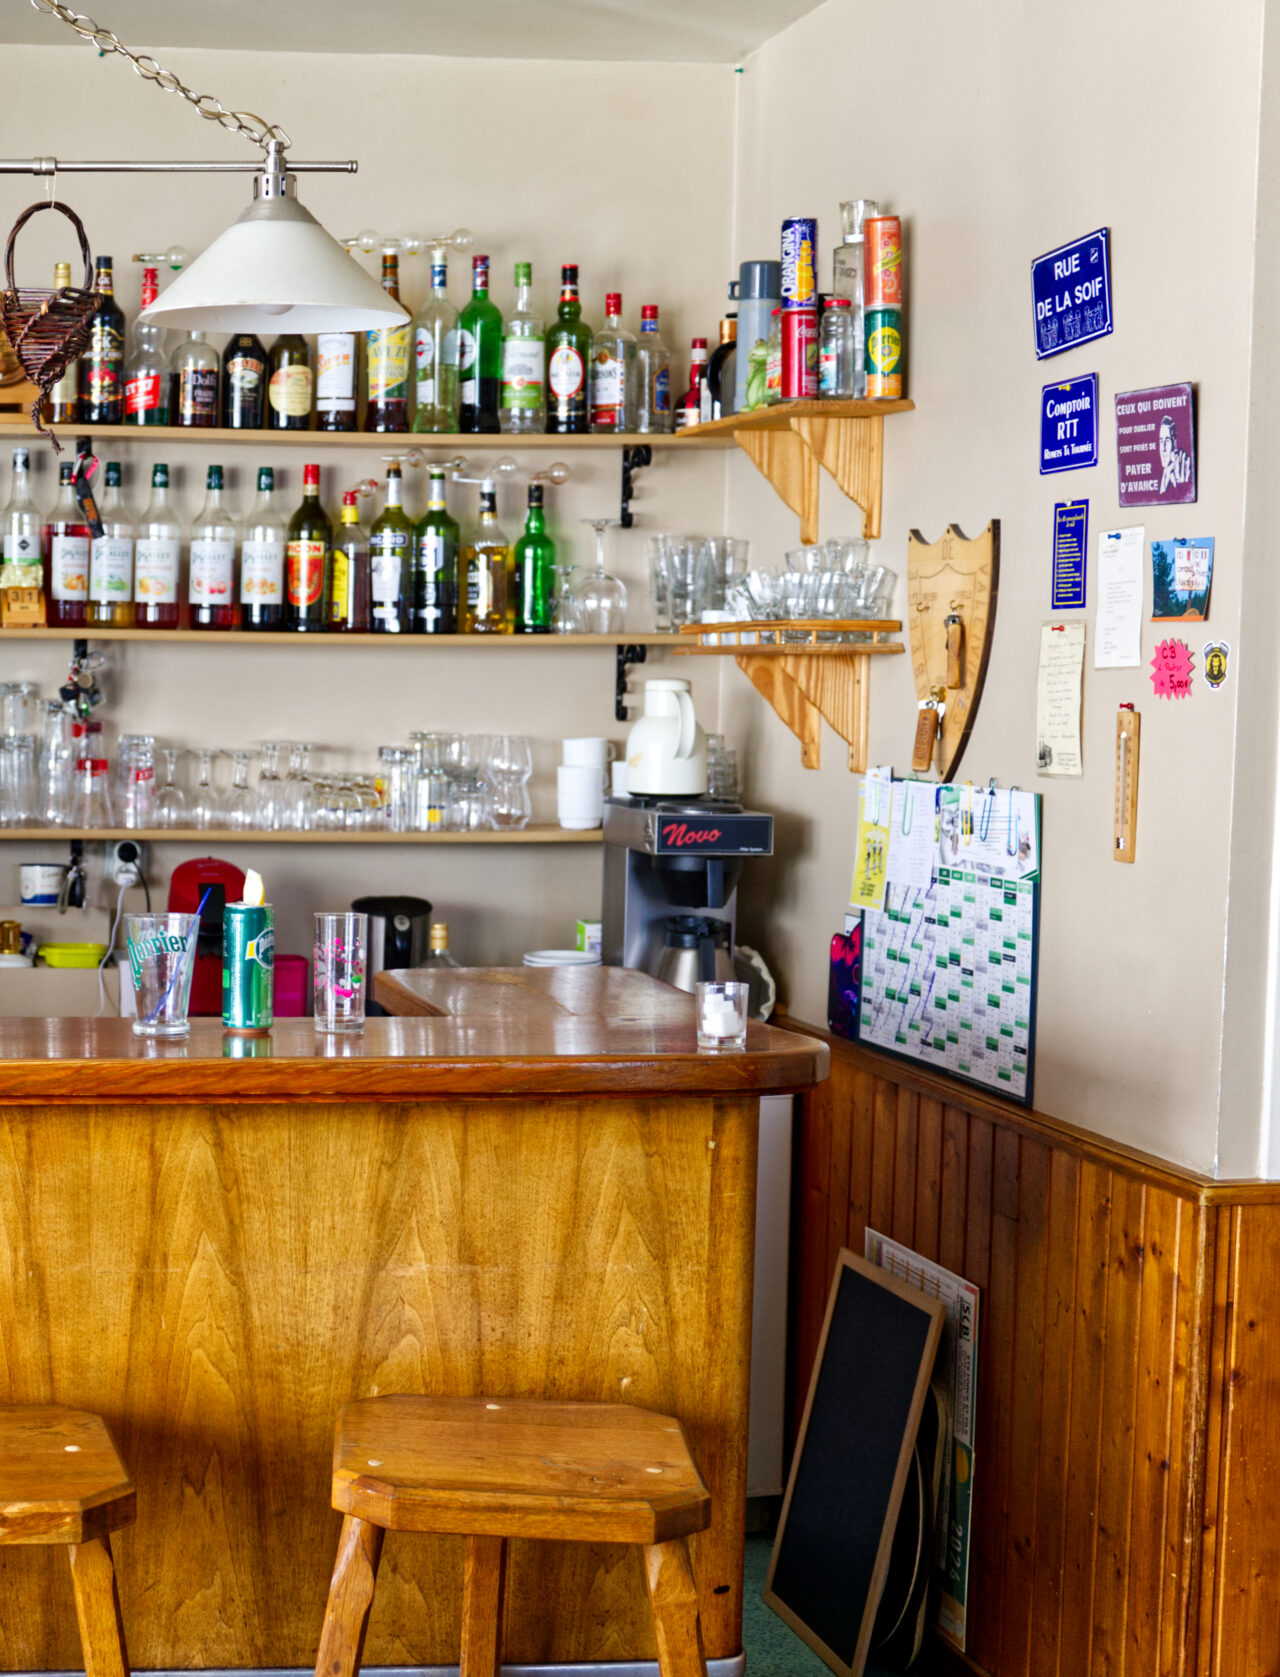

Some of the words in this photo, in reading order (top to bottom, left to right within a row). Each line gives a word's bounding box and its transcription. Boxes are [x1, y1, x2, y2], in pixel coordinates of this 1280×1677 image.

[781, 227, 797, 297] ORANGINA
[1053, 253, 1081, 281] RUE
[1037, 298, 1053, 321] DE
[1055, 290, 1072, 312] LA
[1074, 276, 1103, 305] SOIF
[1116, 403, 1136, 416] CEUX
[1137, 401, 1151, 414] QUI
[1152, 395, 1187, 411] BOIVENT
[1057, 418, 1079, 441] RTT
[1133, 423, 1156, 433] OUBLIER
[1119, 445, 1133, 454] SONT
[1149, 442, 1157, 450] DE
[1125, 463, 1152, 476] PAYER
[1120, 479, 1159, 493] D'AVANCE
[662, 823, 722, 847] Novo
